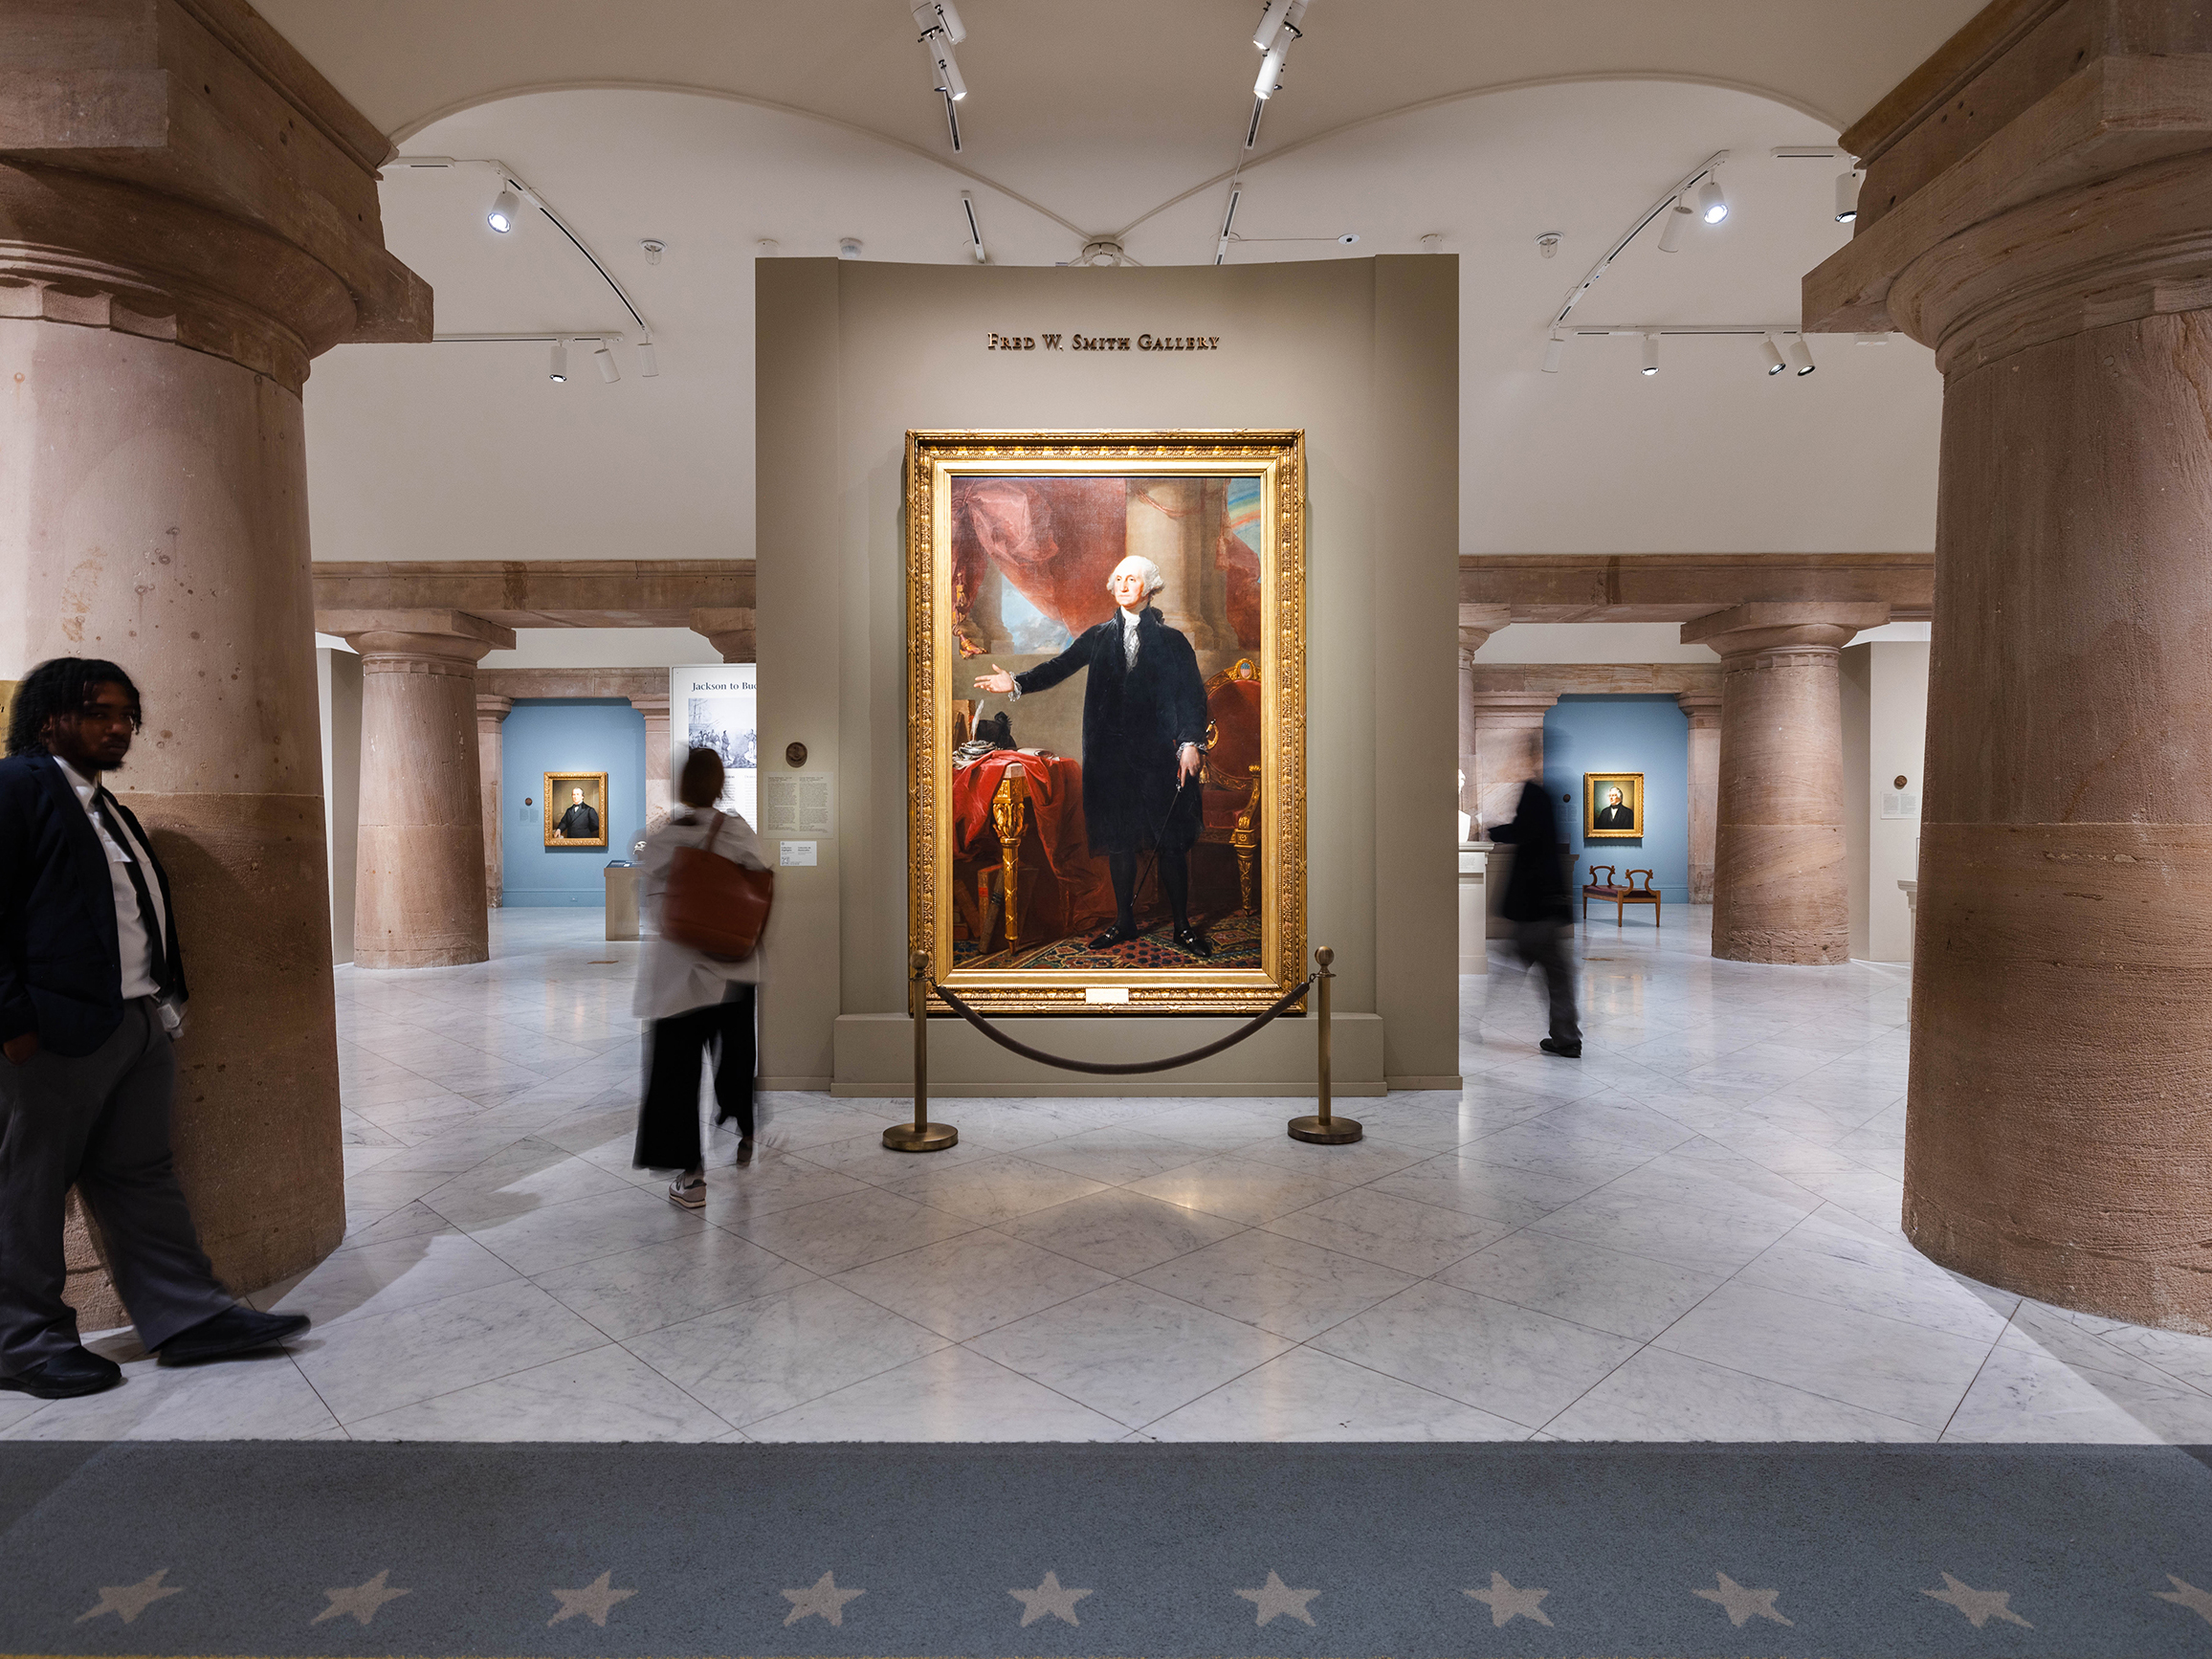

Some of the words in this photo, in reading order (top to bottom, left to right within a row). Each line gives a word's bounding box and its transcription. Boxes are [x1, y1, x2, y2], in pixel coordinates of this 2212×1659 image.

[987, 332, 1035, 351] FRED
[1042, 333, 1064, 351] W.
[1072, 333, 1131, 351] SMITH
[1138, 333, 1220, 351] GALLERY
[692, 682, 727, 692] Jackson
[730, 682, 740, 691] to
